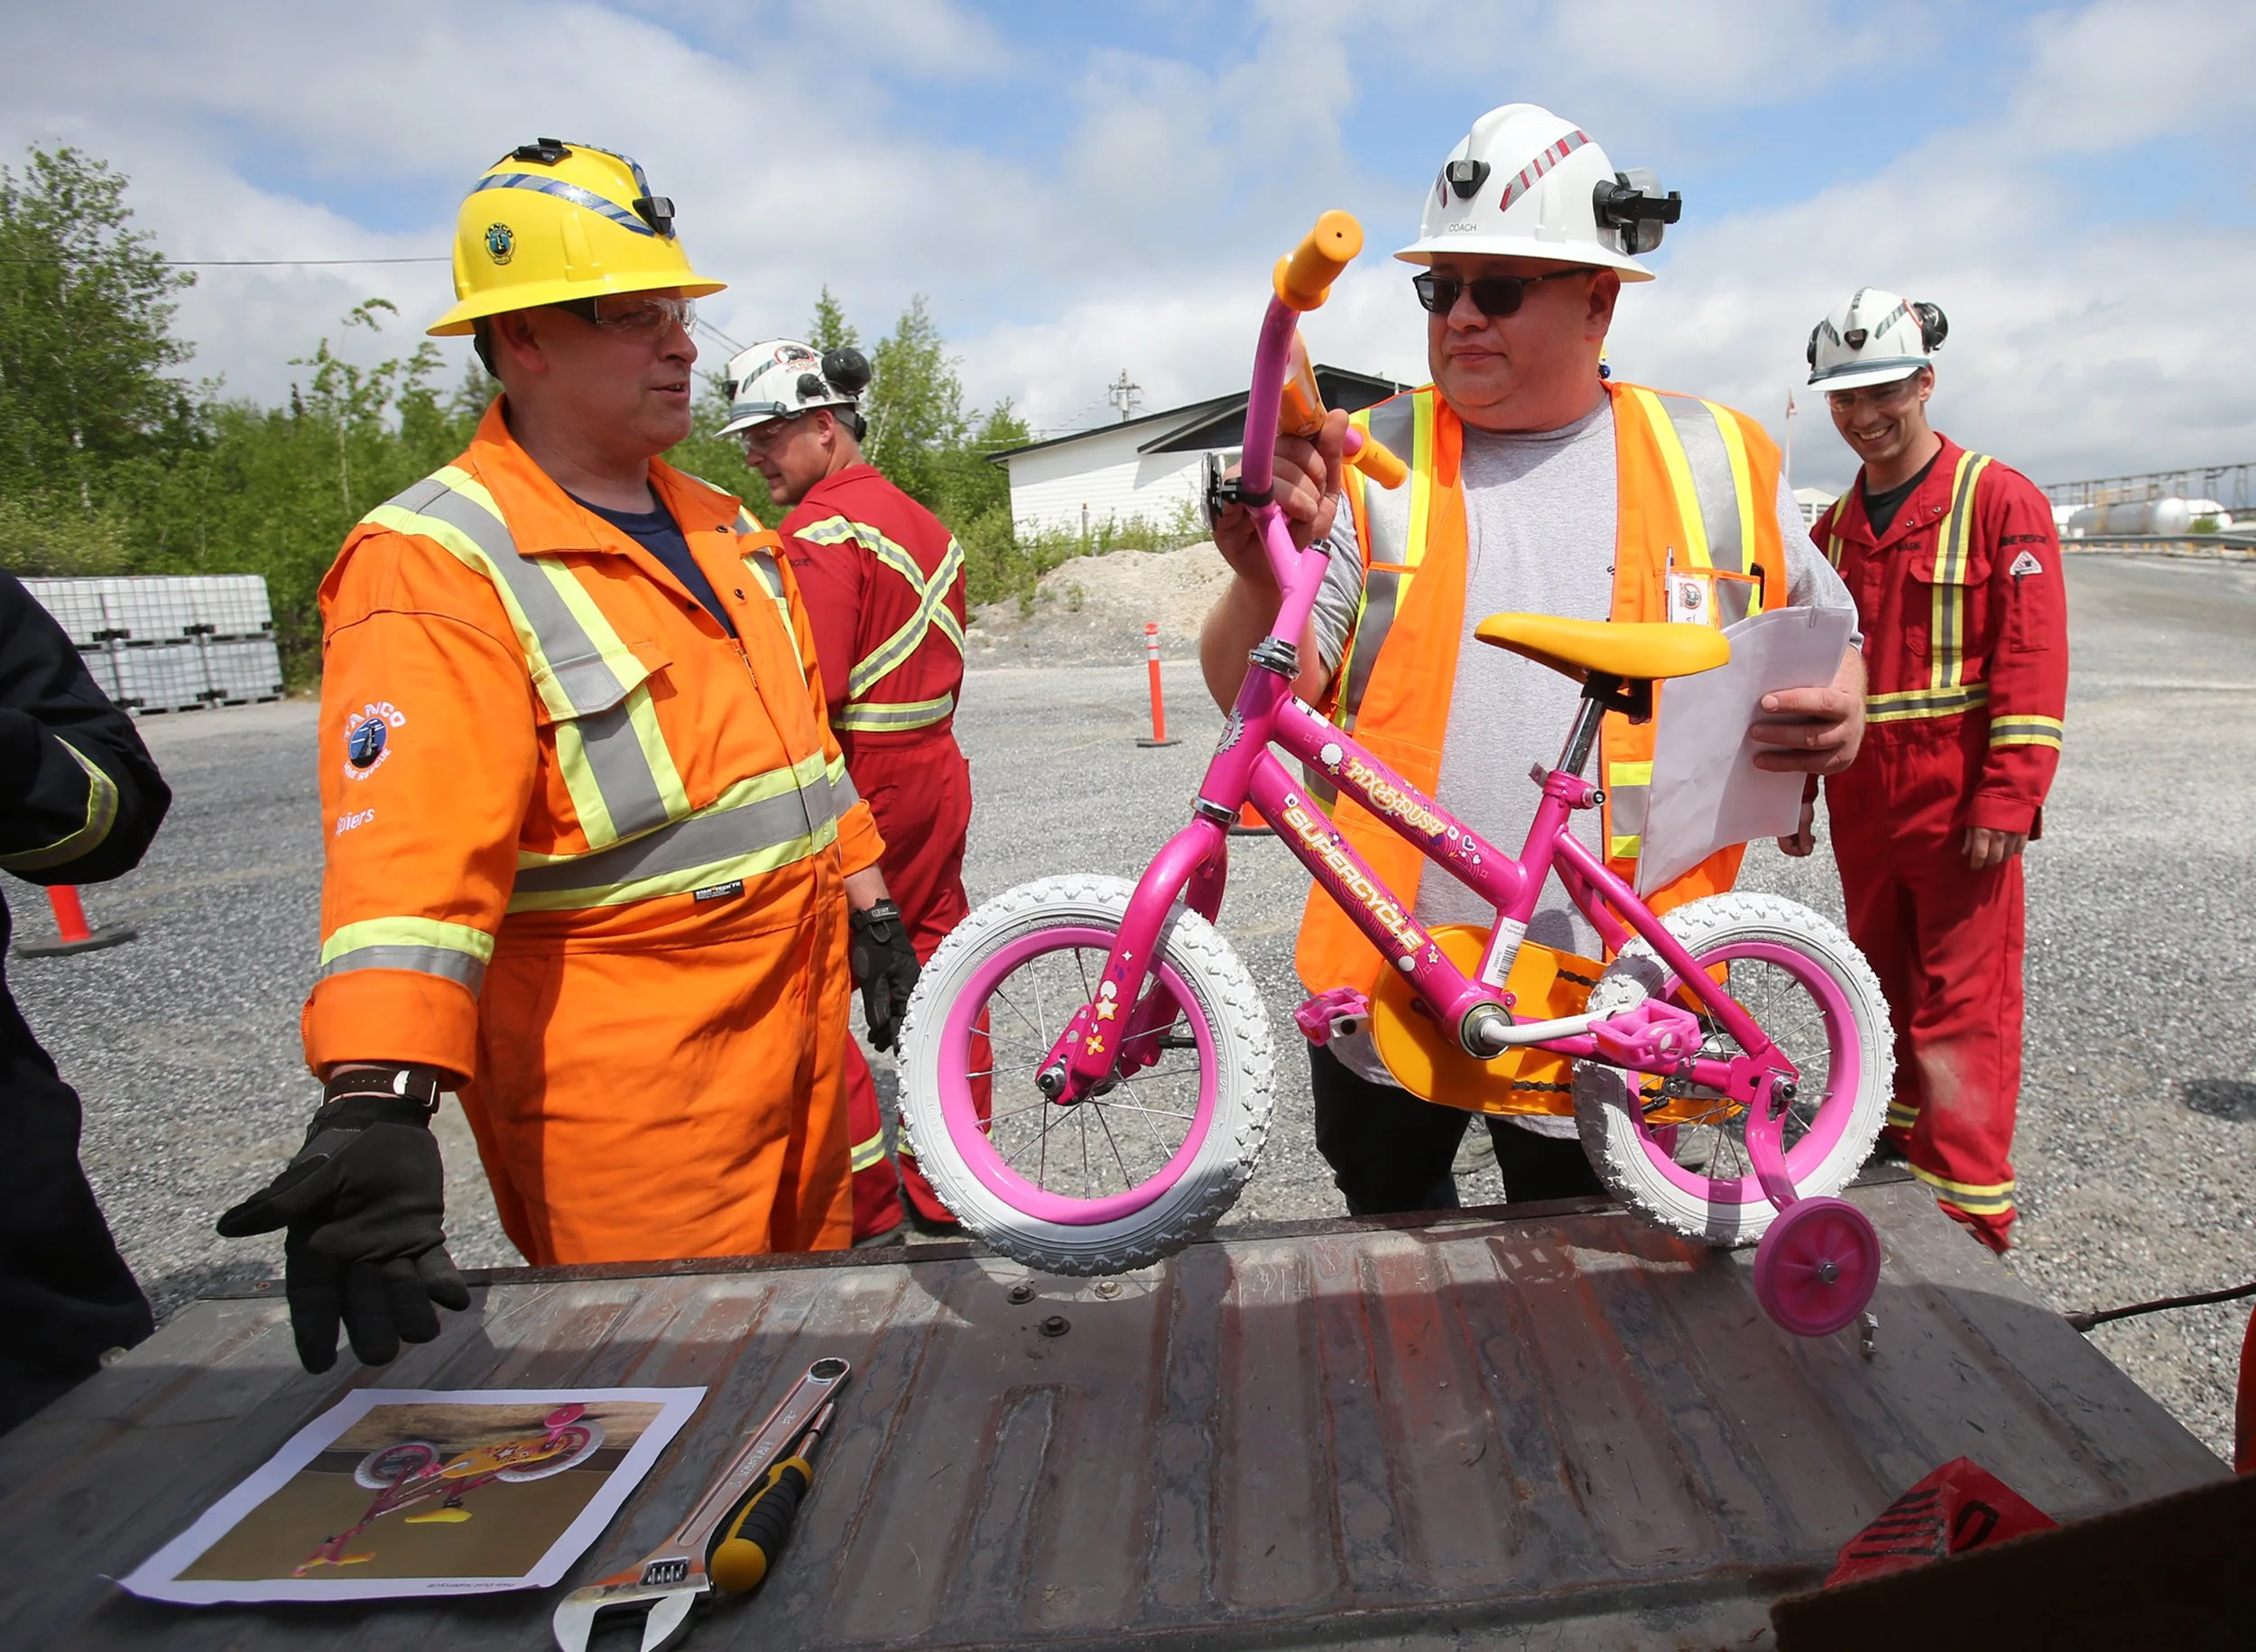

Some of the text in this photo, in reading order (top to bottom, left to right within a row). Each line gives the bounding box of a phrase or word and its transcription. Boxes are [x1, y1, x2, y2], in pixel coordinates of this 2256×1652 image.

[485, 223, 513, 241] TANCO
[1447, 223, 1477, 233] COACH
[343, 701, 406, 743] TANCO
[1283, 806, 1426, 953] SUPERCYCLE
